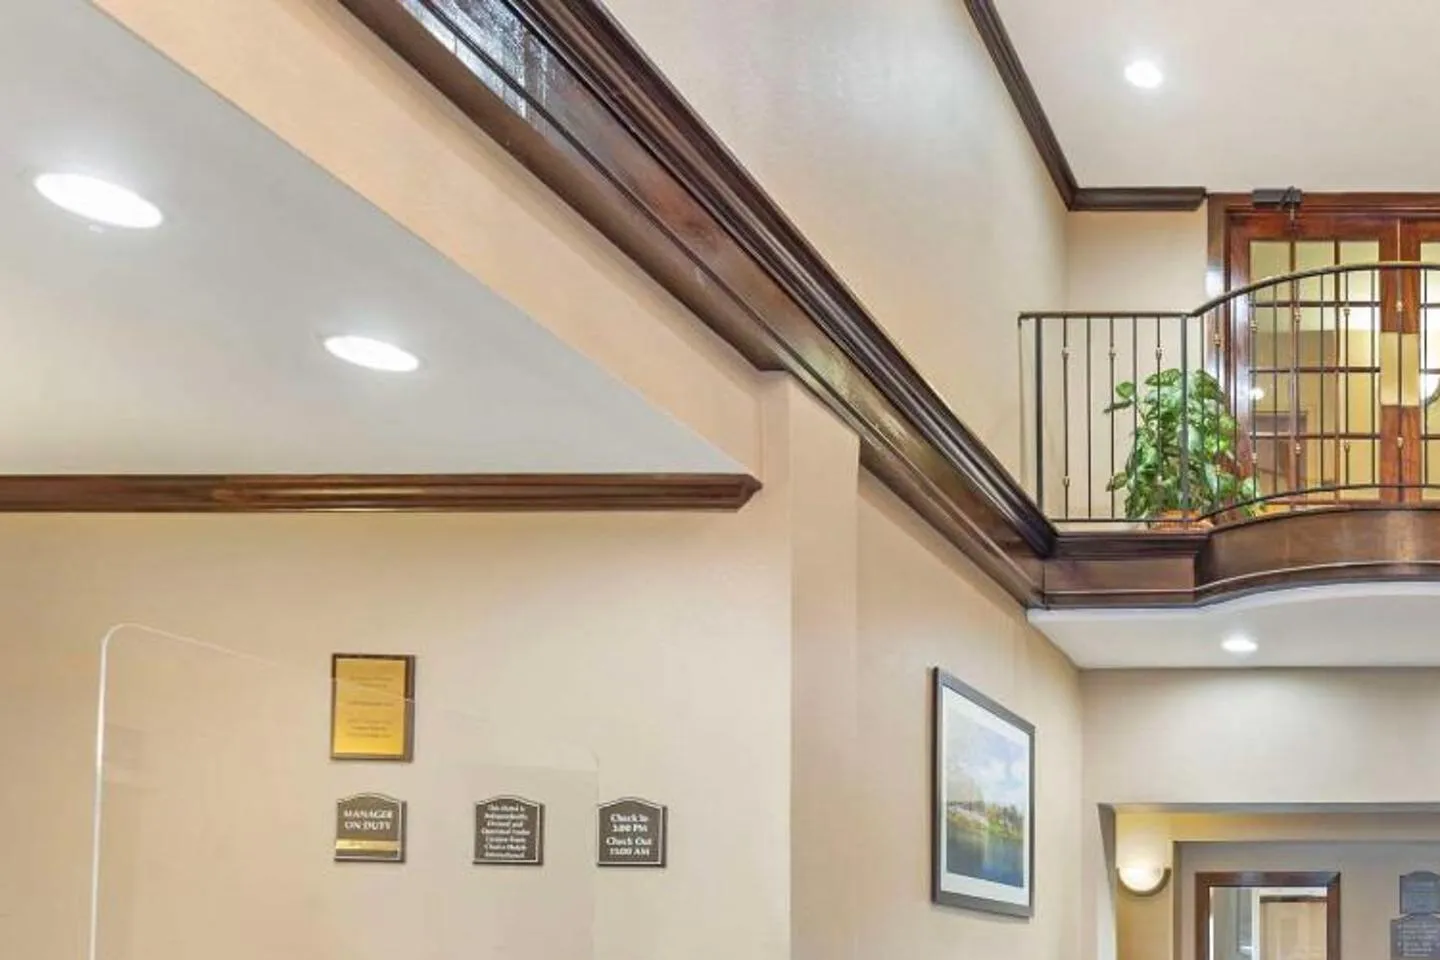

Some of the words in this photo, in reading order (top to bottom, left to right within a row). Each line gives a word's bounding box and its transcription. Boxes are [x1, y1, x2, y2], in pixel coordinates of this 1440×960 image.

[343, 809, 393, 819] MANAGER
[610, 813, 638, 822] Check
[344, 821, 361, 830] ON
[363, 821, 391, 830] DUTY
[633, 823, 648, 832] PM
[606, 836, 633, 846] Check
[635, 836, 651, 846] Out
[633, 847, 650, 856] AM
